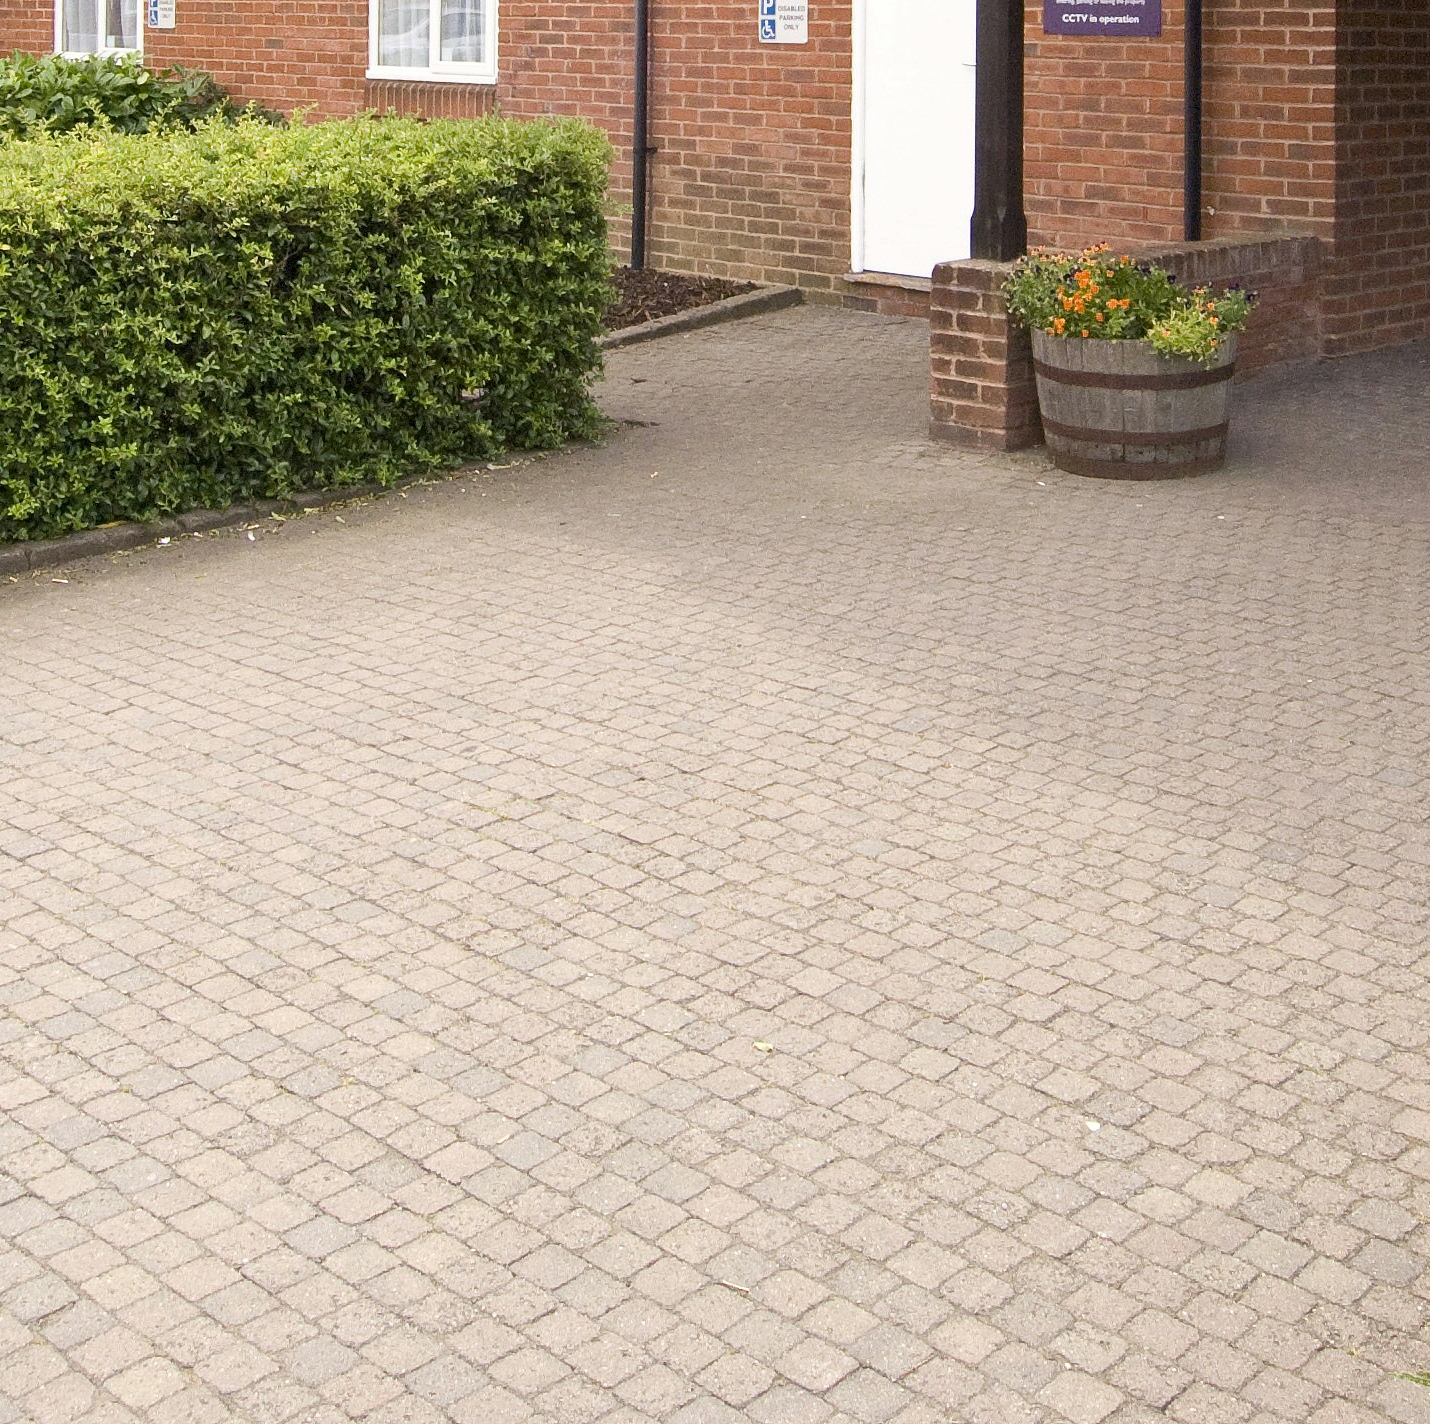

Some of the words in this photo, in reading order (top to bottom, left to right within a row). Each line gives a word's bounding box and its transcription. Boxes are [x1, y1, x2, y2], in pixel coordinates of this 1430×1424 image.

[1061, 14, 1088, 23] CCTV
[1089, 14, 1097, 23] in
[1099, 14, 1140, 25] operation
